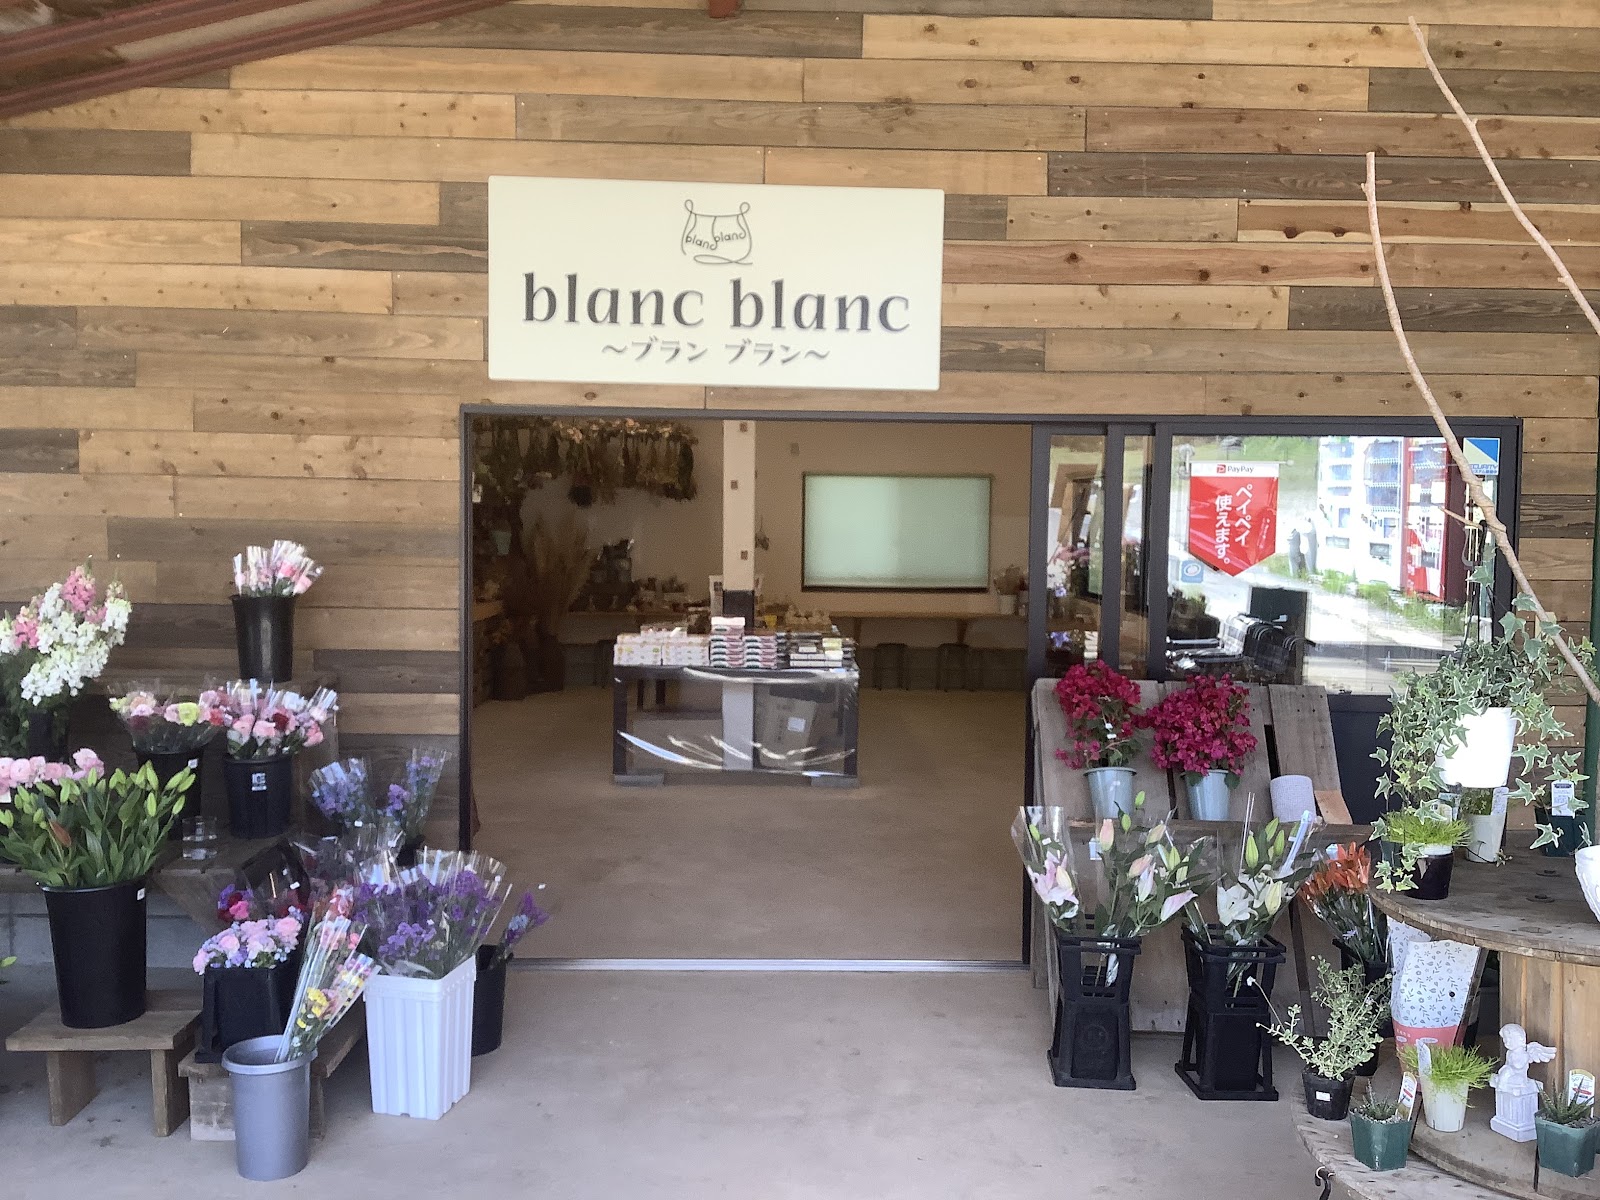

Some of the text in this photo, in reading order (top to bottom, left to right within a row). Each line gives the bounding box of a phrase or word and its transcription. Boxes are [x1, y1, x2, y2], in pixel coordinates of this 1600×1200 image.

[523, 272, 910, 332] blanc blanc
[1214, 494, 1232, 564] 使えます。
[1234, 483, 1253, 547] ペイペイ
